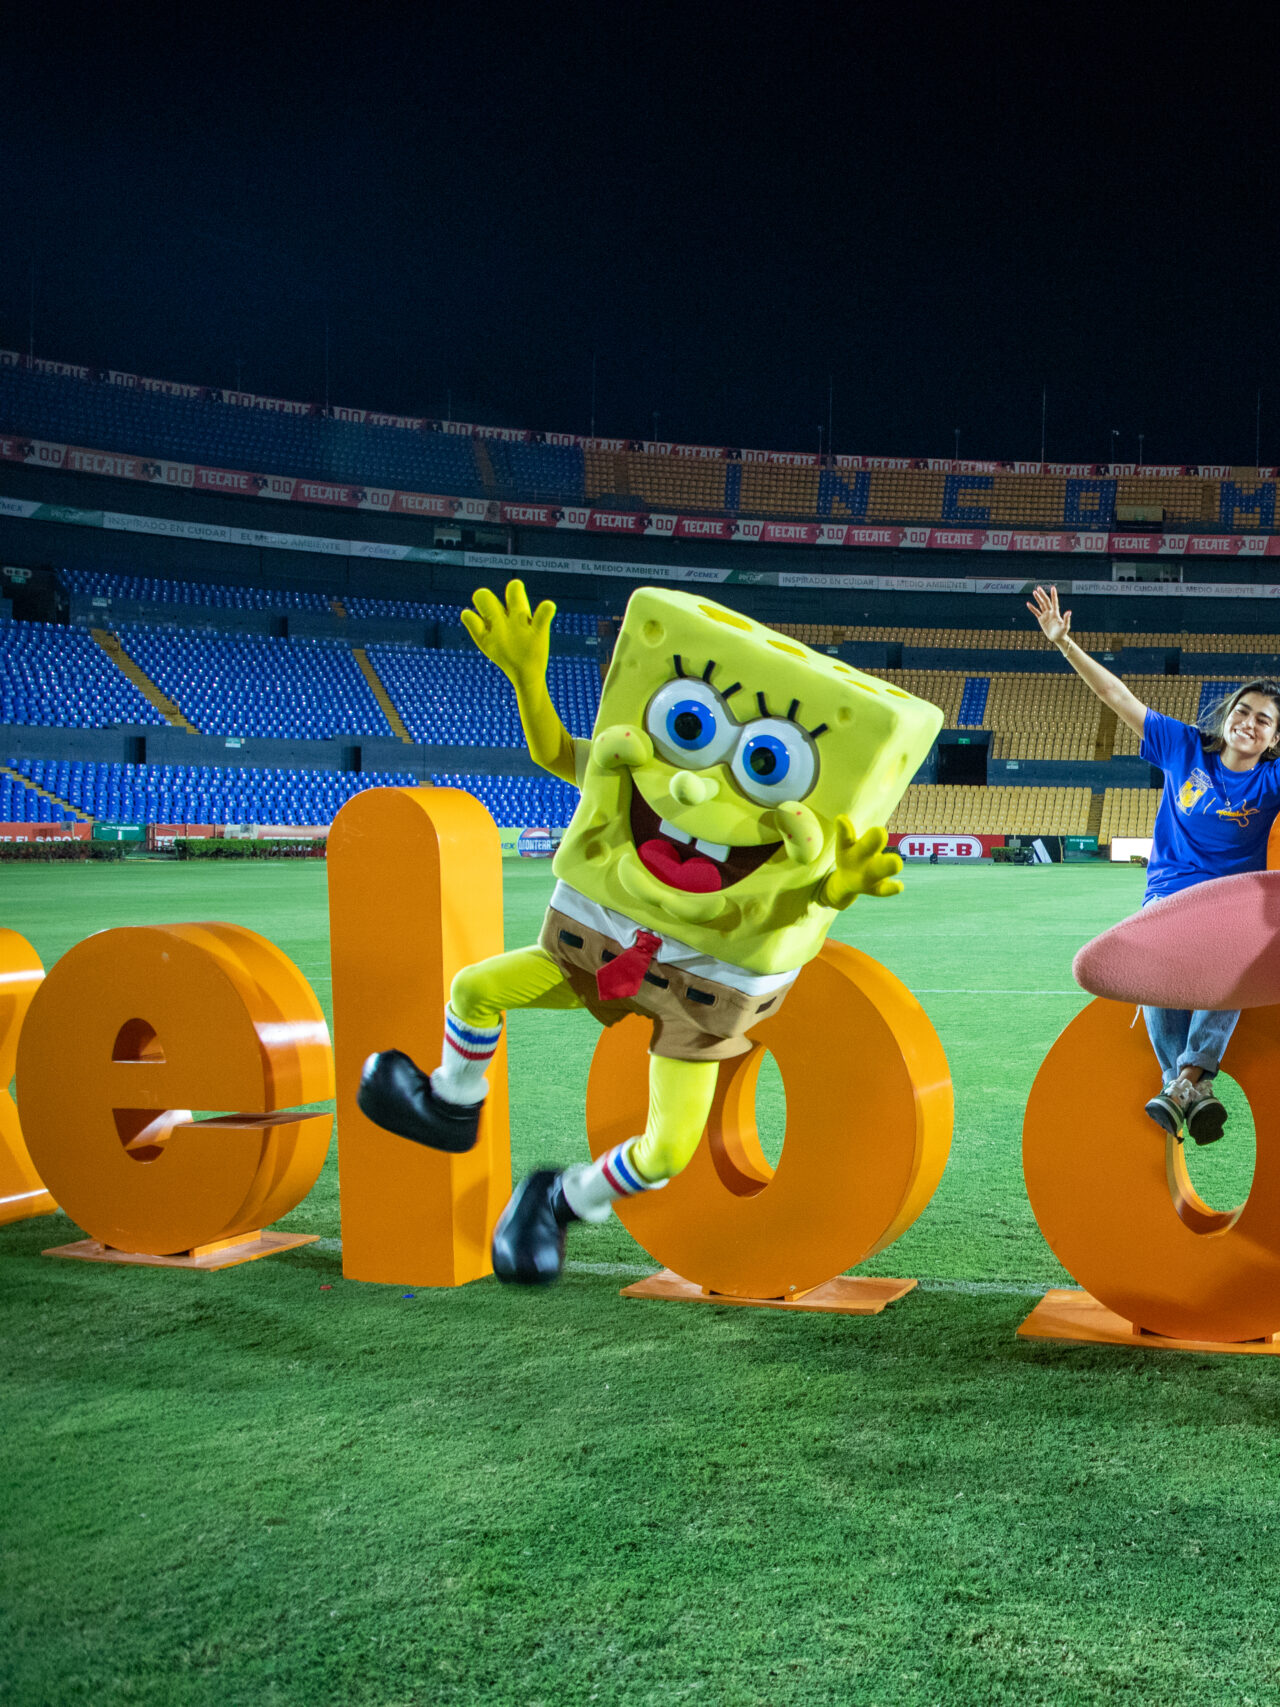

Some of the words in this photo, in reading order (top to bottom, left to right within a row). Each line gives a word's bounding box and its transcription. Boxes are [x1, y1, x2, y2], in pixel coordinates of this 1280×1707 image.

[36, 359, 89, 380] TECATE
[142, 378, 200, 398] TECATE
[256, 397, 312, 415] TECATE
[370, 413, 425, 429] TECATE
[476, 426, 527, 441] TECATE
[578, 437, 625, 449] TECATE
[676, 445, 723, 459] TECATE
[771, 453, 817, 465] TECATE
[866, 458, 911, 469] TECATE
[953, 460, 996, 473] TECATE
[1049, 464, 1092, 476] TECATE
[1136, 465, 1183, 477] TECATE
[70, 452, 136, 477] TECATE
[199, 470, 248, 489] TECATE
[300, 485, 349, 501] TECATE
[400, 495, 445, 511] TECATE
[504, 506, 548, 521] TECATE
[593, 513, 636, 529] TECATE
[682, 520, 723, 535] TECATE
[767, 525, 808, 539] TECATE
[851, 529, 891, 542] TECATE
[934, 532, 974, 545] TECATE
[1013, 535, 1062, 549] TECATE
[1112, 537, 1151, 549] TECATE
[1192, 538, 1231, 550] TECATE
[109, 518, 167, 531] INSPIRADO
[170, 524, 184, 533] EN
[187, 527, 226, 538] CUIDAR
[240, 532, 253, 541] EL
[254, 534, 288, 545] MEDIO
[291, 540, 341, 551] AMBIENTE
[468, 555, 518, 567] INSPIRADO
[520, 559, 534, 567] EN
[535, 560, 569, 569] CUIDAR
[581, 563, 591, 571] EL
[593, 564, 623, 573] MEDIO
[625, 566, 670, 576] AMBIENTE
[782, 576, 827, 586] INSPIRADO
[843, 577, 874, 586] CUIDAR
[885, 580, 894, 588] EL
[897, 580, 924, 588] MEDIO
[926, 581, 968, 590] AMBIENTE
[1076, 583, 1118, 592] INSPIRADO
[1134, 585, 1163, 593] CUIDAR
[1186, 586, 1212, 594] MEDIO
[1215, 587, 1255, 595] AMBIENTE
[518, 840, 552, 850] MONTERR
[908, 842, 972, 856] H-E-B
